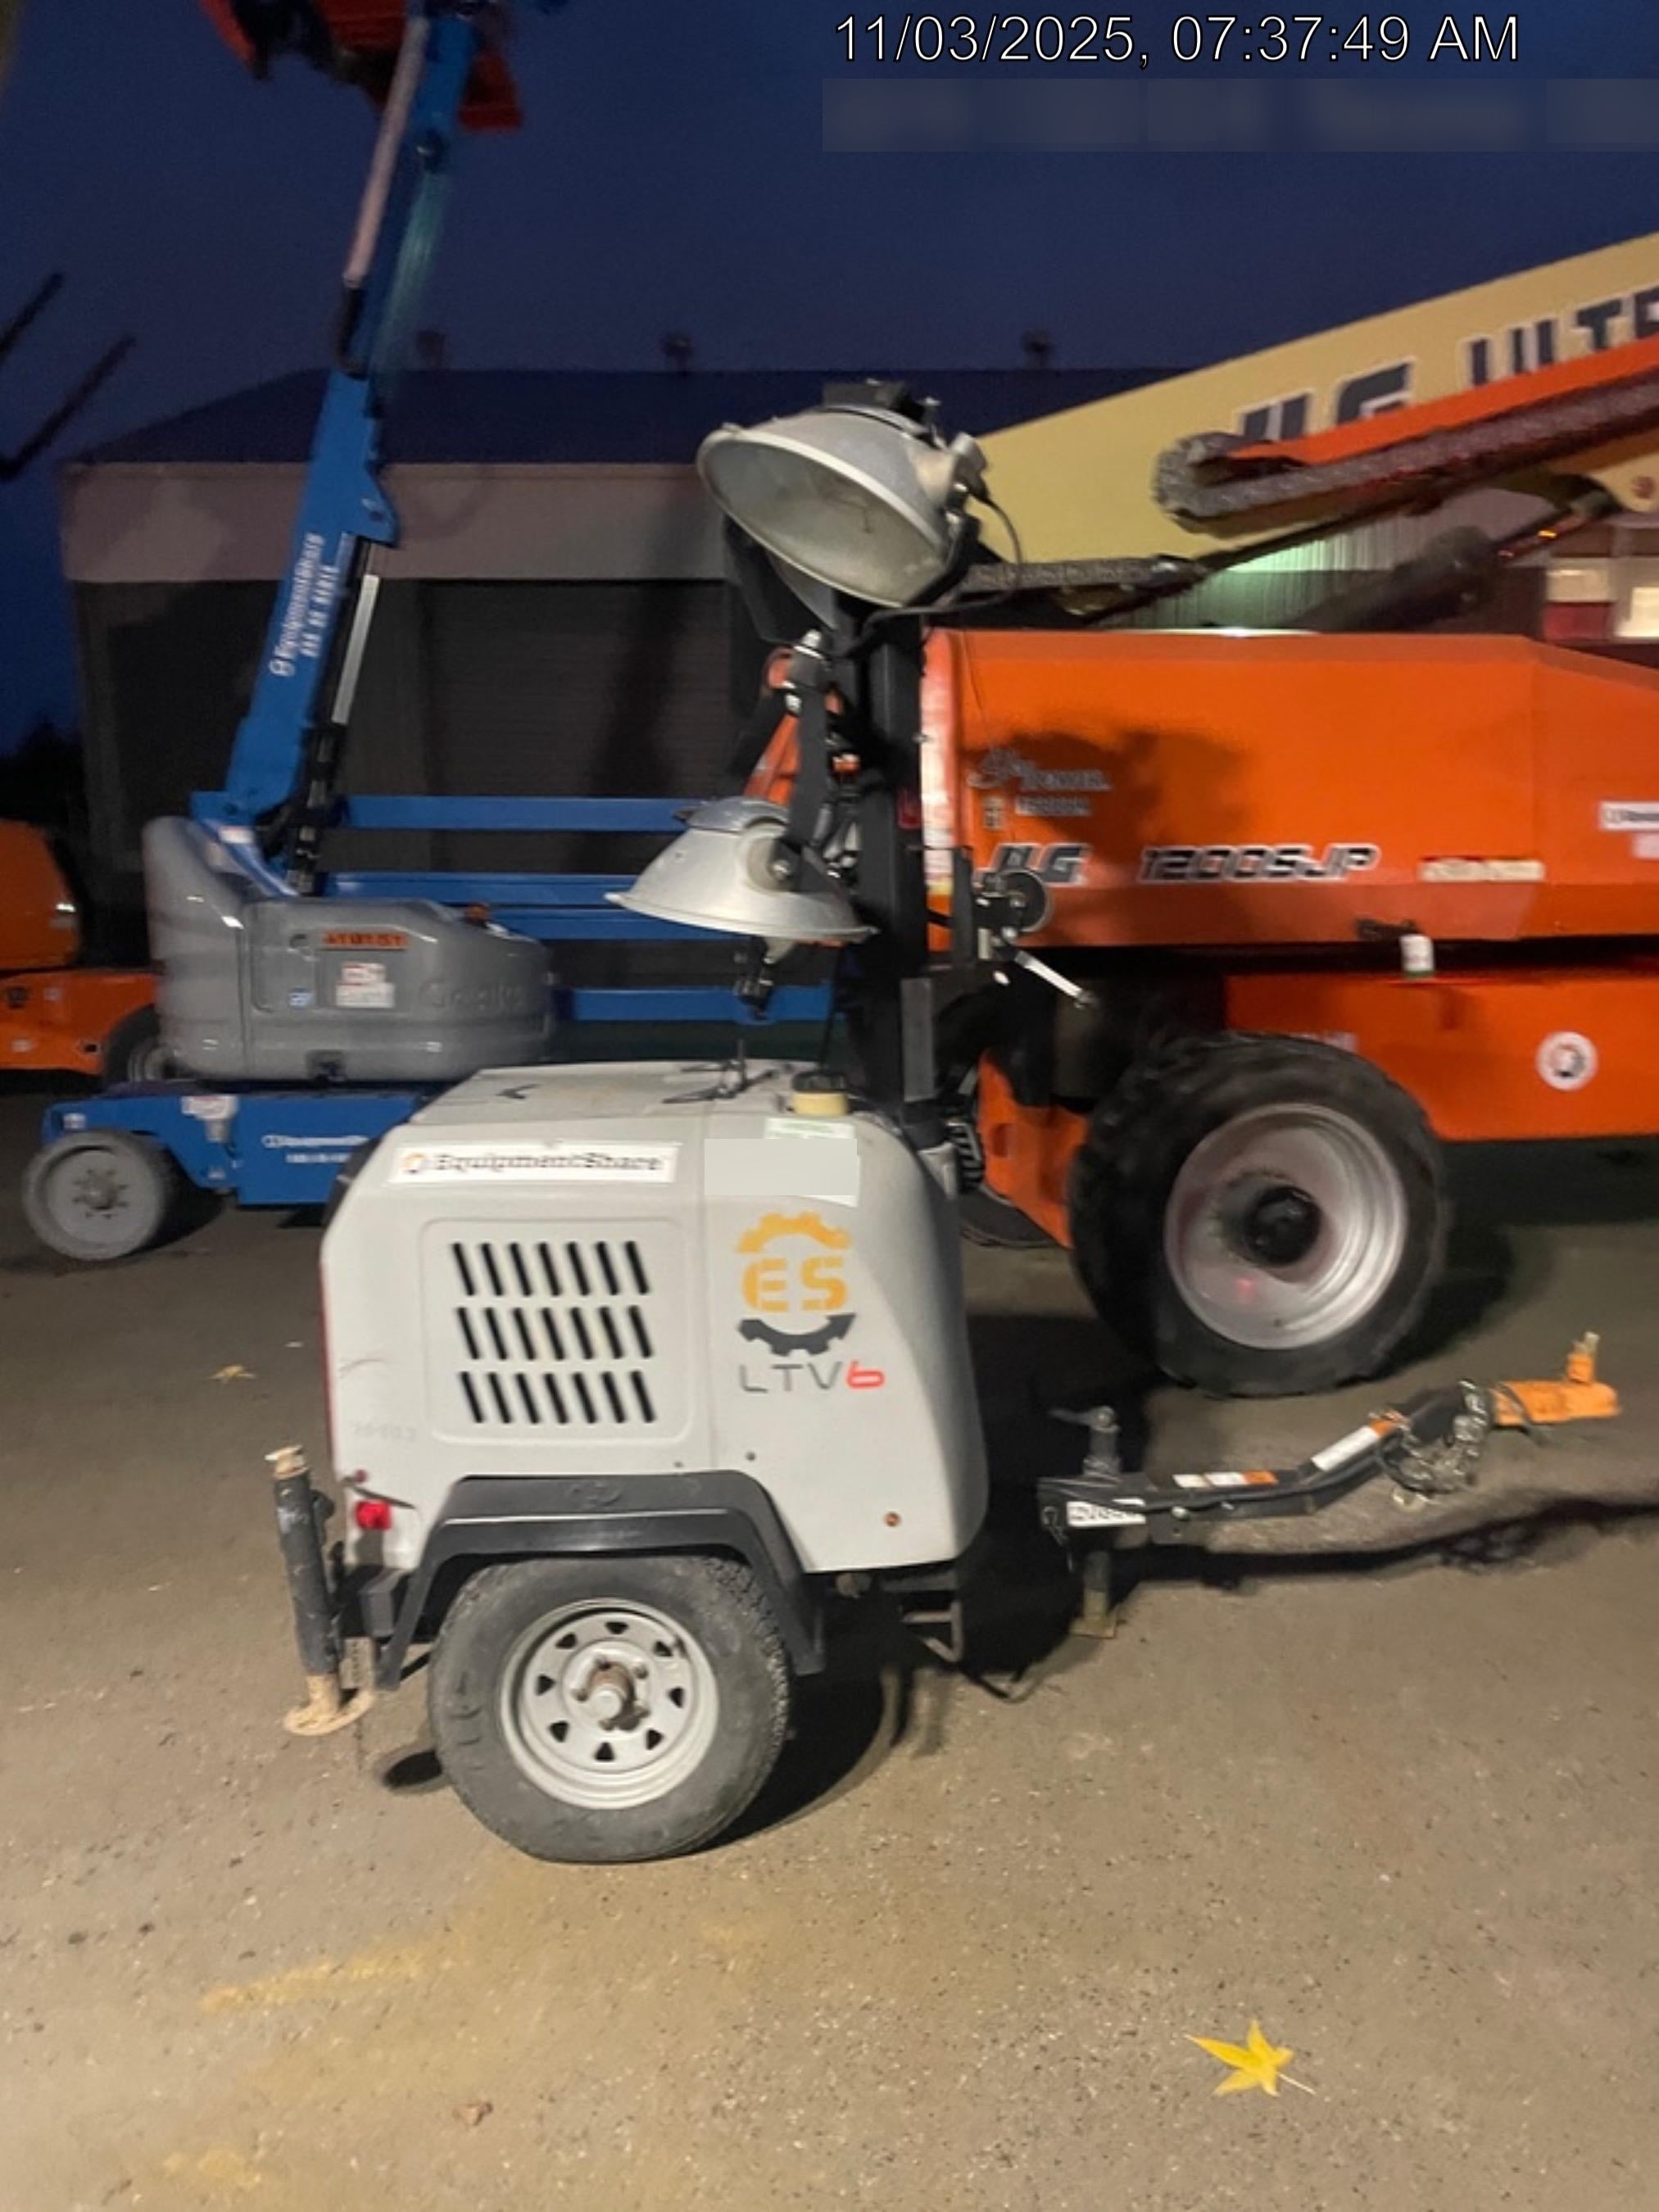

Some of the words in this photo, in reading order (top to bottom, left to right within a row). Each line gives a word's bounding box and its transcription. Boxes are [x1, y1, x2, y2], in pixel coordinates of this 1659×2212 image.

[1137, 844, 1380, 884] 1200SJP
[436, 1151, 664, 1172] EquipmentShare
[741, 1255, 849, 1313] ES
[738, 1359, 886, 1394] LTV6
